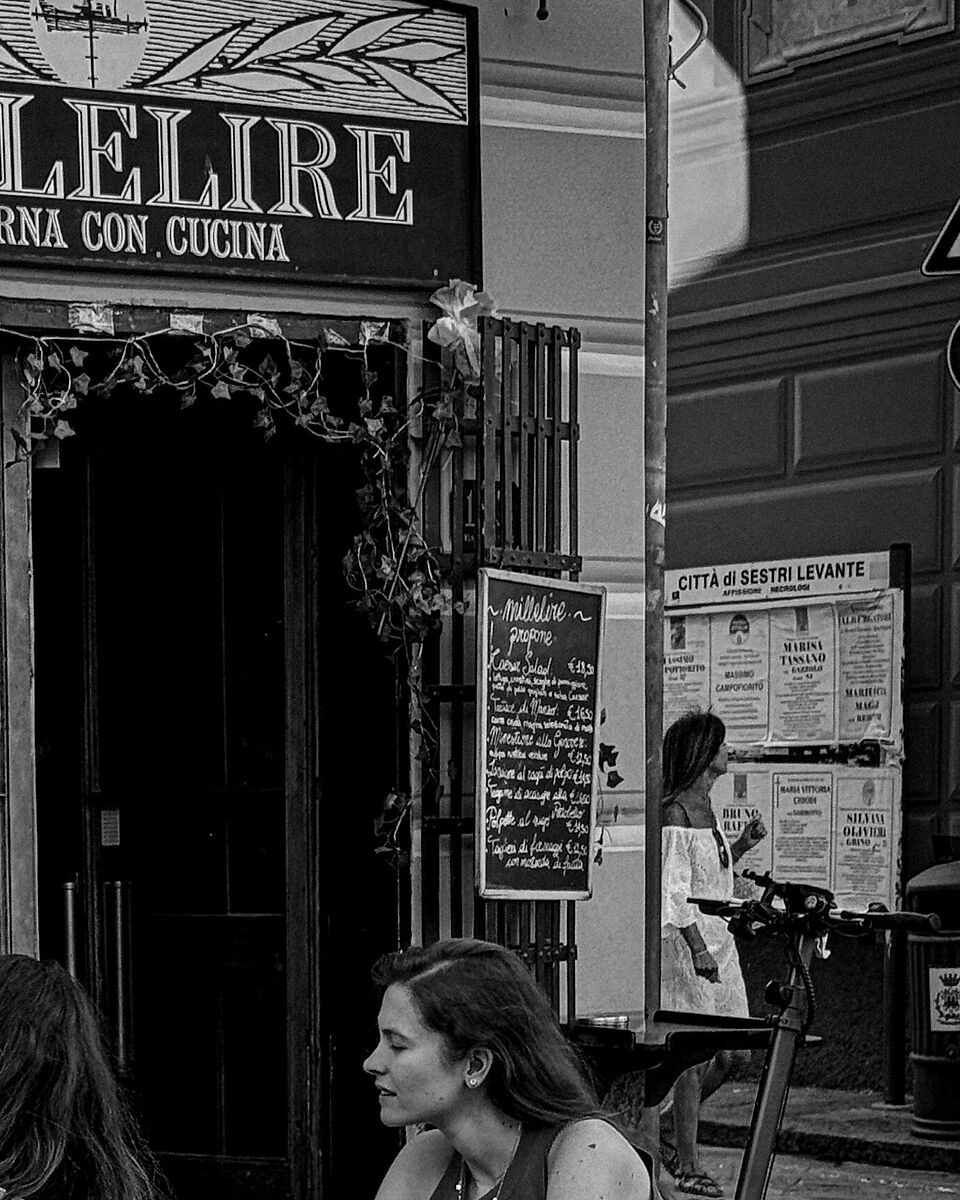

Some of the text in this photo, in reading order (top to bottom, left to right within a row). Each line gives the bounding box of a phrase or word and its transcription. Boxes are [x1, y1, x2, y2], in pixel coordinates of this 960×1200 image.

[80, 210, 148, 255] CON
[165, 218, 291, 264] CUCINA
[678, 561, 865, 591] CITTÀ di SESTRI LEVANTE
